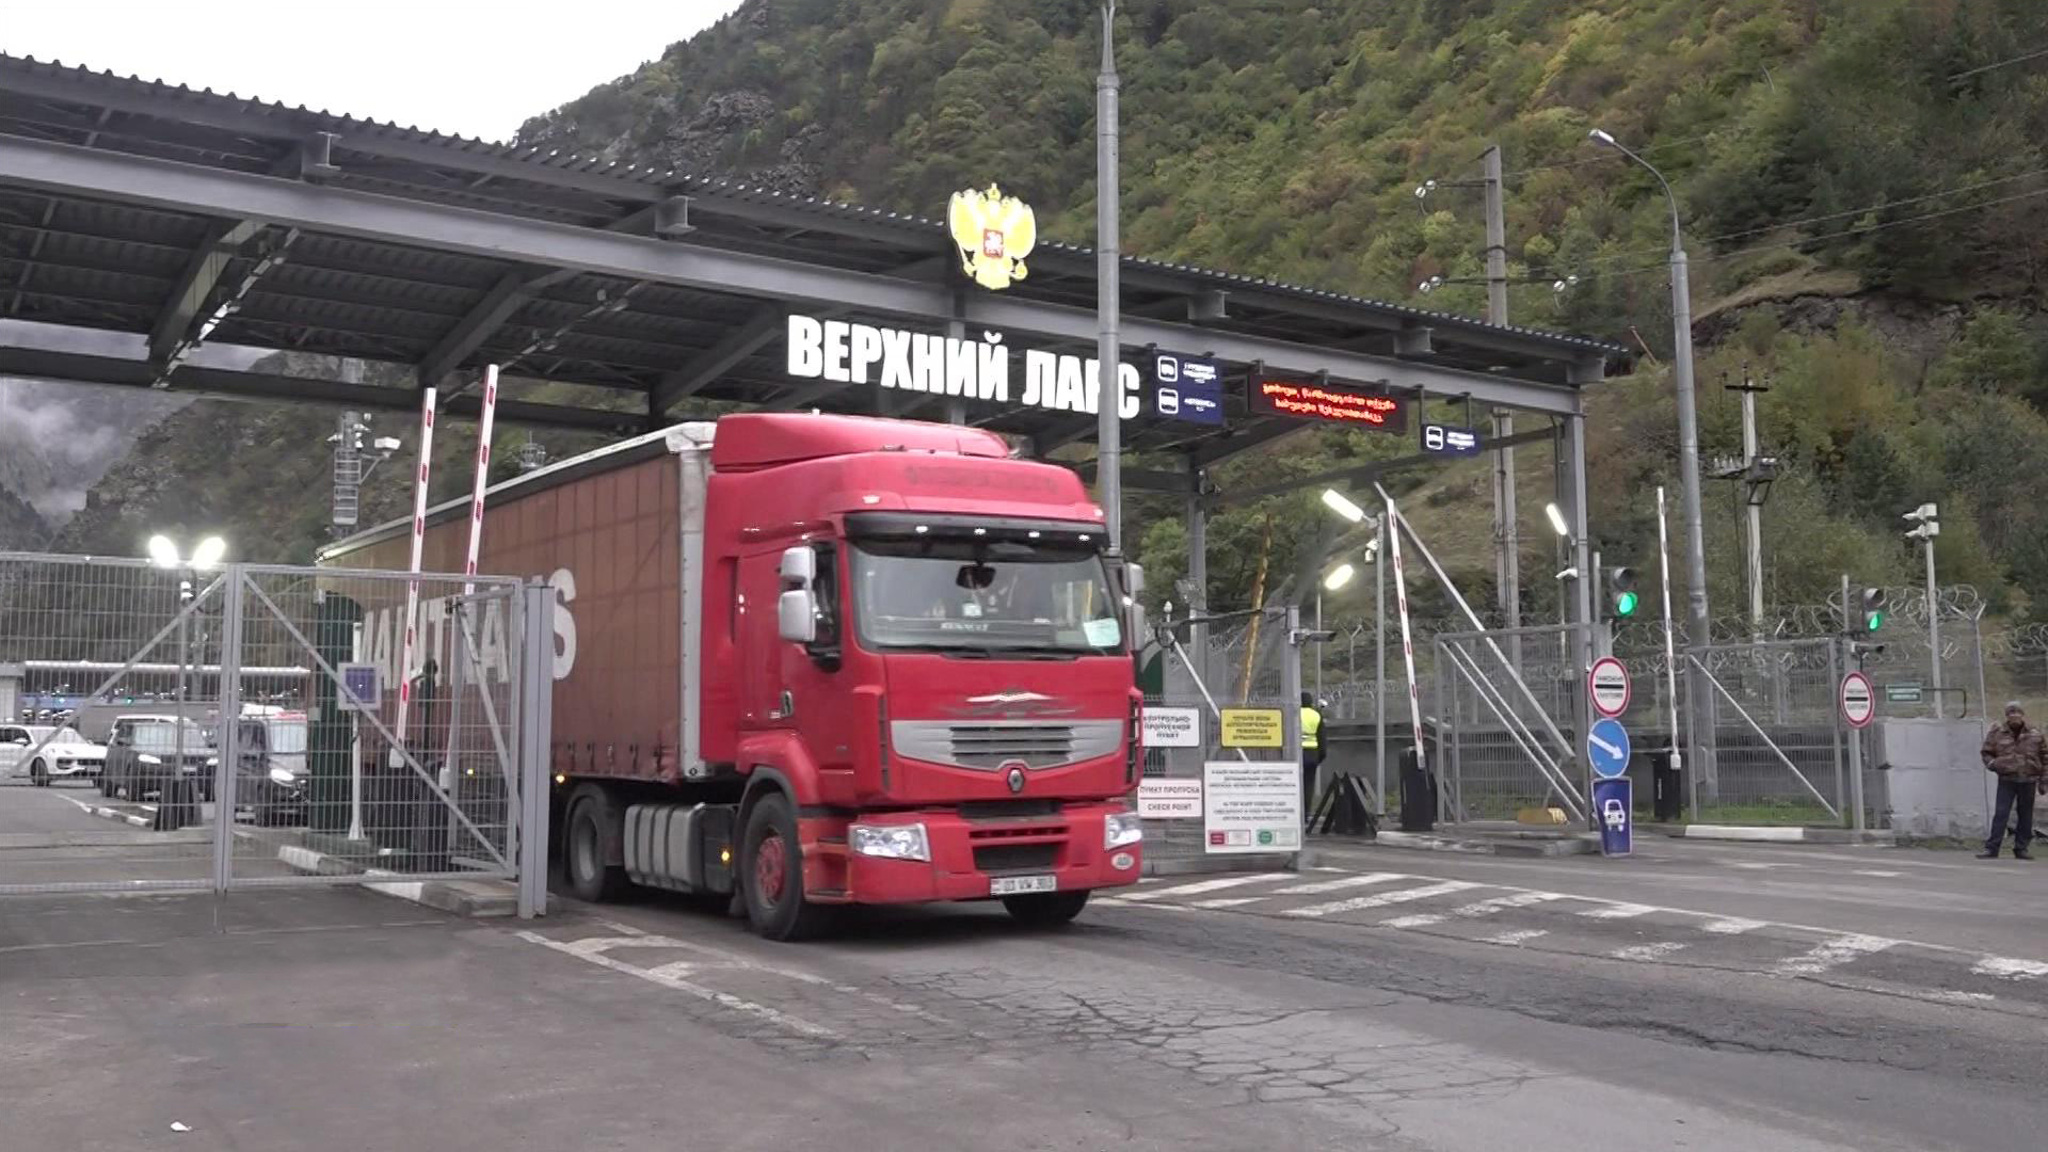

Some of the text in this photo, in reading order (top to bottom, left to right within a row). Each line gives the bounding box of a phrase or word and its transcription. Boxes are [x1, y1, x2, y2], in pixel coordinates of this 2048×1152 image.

[788, 314, 1008, 402] ВЕРХНИЙ
[1163, 786, 1200, 794] ПРОПУСКА
[1147, 803, 1192, 811] CHECK POINT
